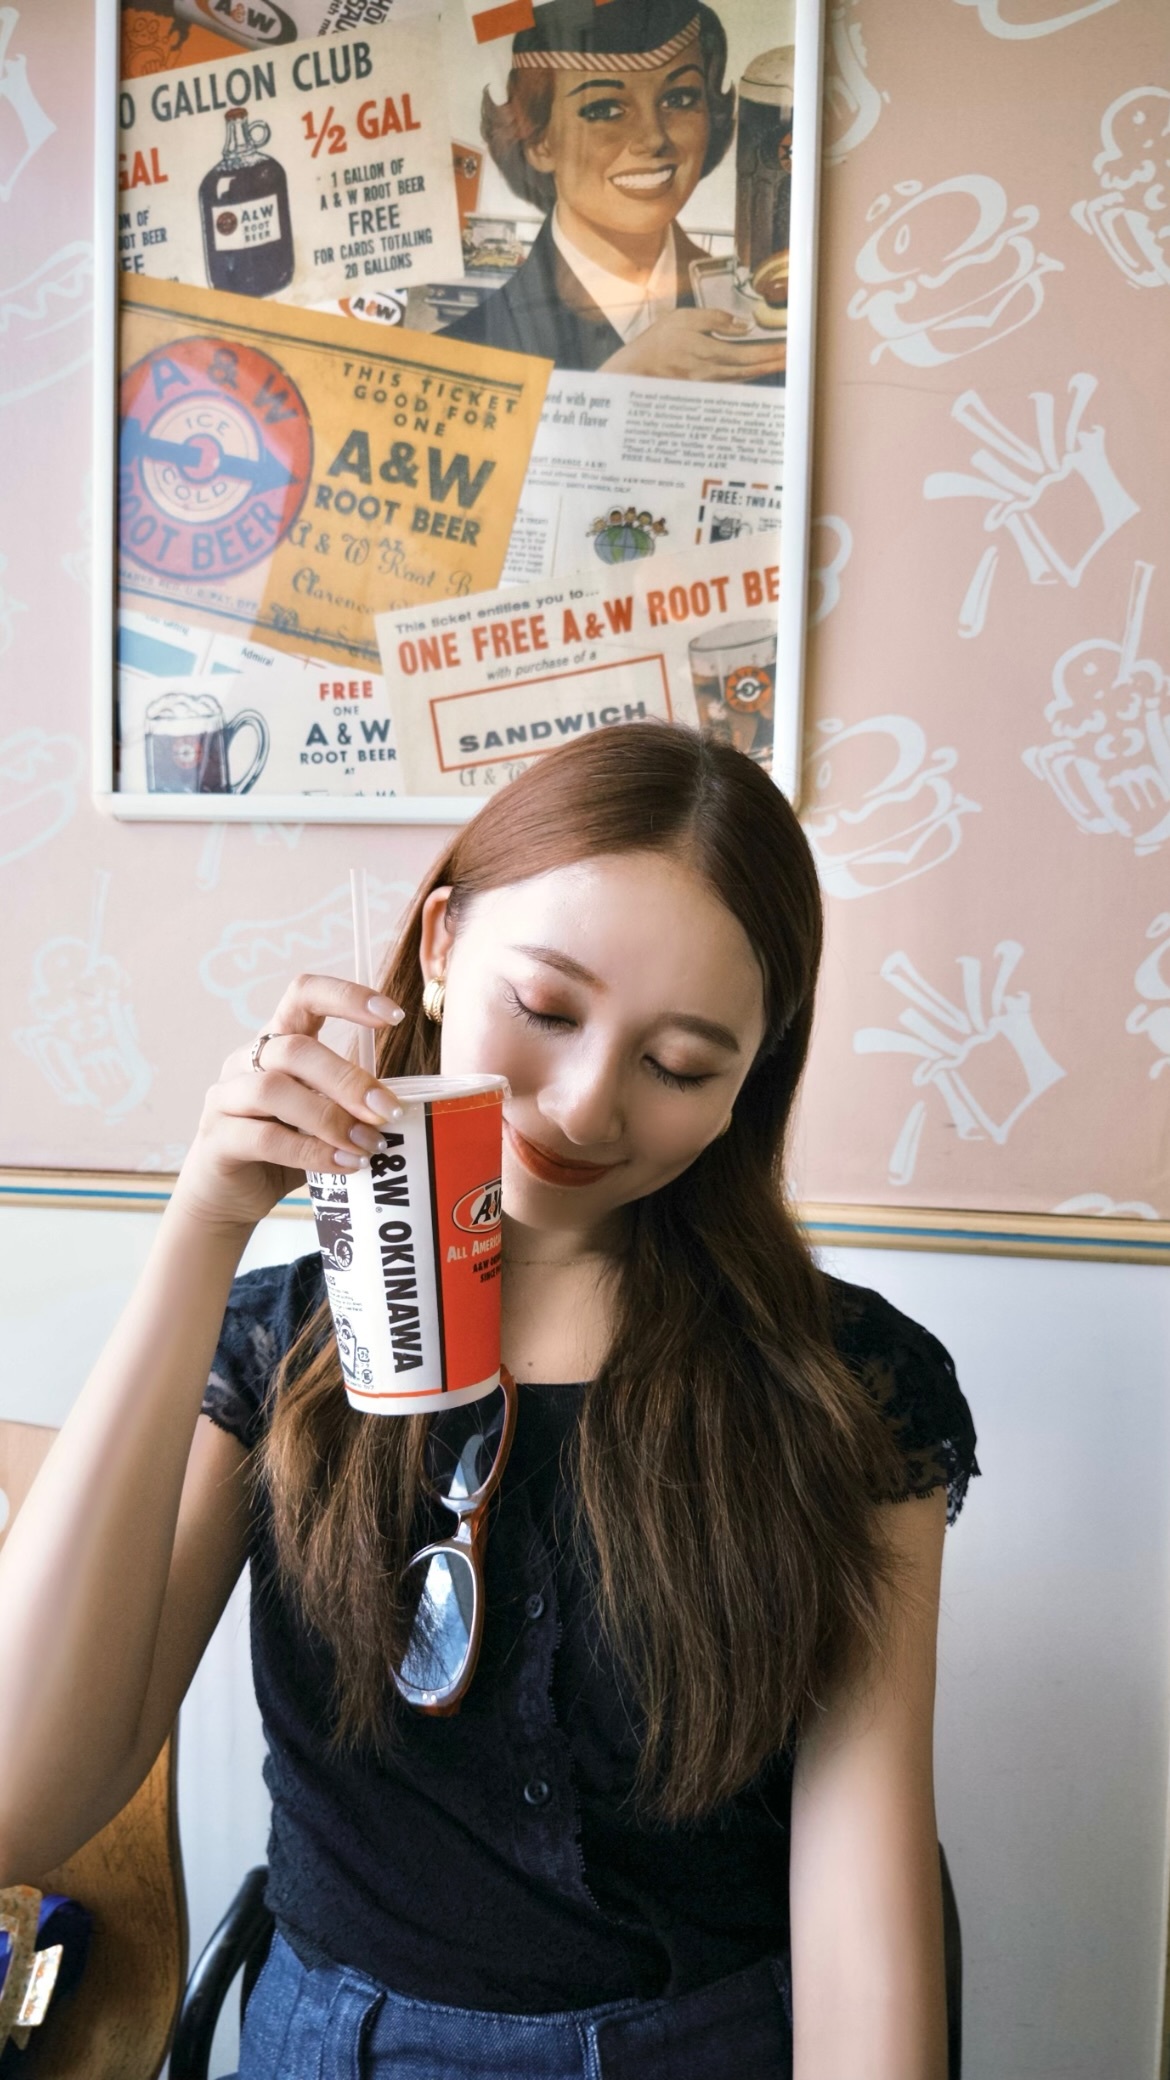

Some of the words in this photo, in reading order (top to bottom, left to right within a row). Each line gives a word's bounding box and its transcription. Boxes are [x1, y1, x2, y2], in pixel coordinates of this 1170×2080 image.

[213, 0, 277, 34] A&W
[151, 61, 277, 122] GALLON
[292, 41, 373, 91] CLUB
[356, 93, 422, 140] GAL
[343, 165, 385, 187] GALLON
[391, 158, 405, 176] OF
[320, 194, 329, 211] A
[333, 192, 343, 209] &
[346, 188, 360, 206] W
[363, 182, 391, 204] ROOT
[397, 175, 426, 196] BEER
[348, 203, 401, 237] FREE
[313, 247, 335, 266] FOR
[340, 239, 376, 261] CARDS
[380, 227, 433, 252] TOTALING
[364, 252, 413, 277] GALLONS
[352, 296, 396, 322] A&W
[343, 362, 401, 388] THIS
[421, 378, 518, 415] TICKET
[185, 412, 230, 437] ICE
[354, 385, 428, 413] GOOD
[446, 405, 498, 430] FOR
[394, 412, 446, 437] ONE
[162, 466, 228, 504] COLD
[326, 429, 497, 510] A&W
[314, 484, 401, 525] ROOT
[411, 506, 482, 547] BEER
[710, 490, 742, 506] FREE:
[192, 500, 284, 571] BEER
[396, 622, 426, 636] This
[432, 613, 472, 629] ticket
[477, 600, 531, 619] entitles
[536, 592, 564, 610] you
[398, 631, 462, 677] ONE
[471, 613, 549, 664] FREE
[561, 596, 634, 645] A&W
[646, 576, 730, 627] ROOT
[241, 647, 275, 666] Admiral
[486, 666, 512, 682] with
[515, 657, 569, 681] purchase
[574, 651, 588, 665] of
[319, 680, 373, 701] FREE
[333, 706, 359, 716] ONE
[458, 701, 647, 754] SANDWICH
[305, 723, 329, 746] A
[337, 722, 352, 745] &
[360, 719, 391, 744] W
[300, 751, 347, 765] ROOT
[358, 748, 397, 762] BEER
[378, 1220, 424, 1374] OKINAWA
